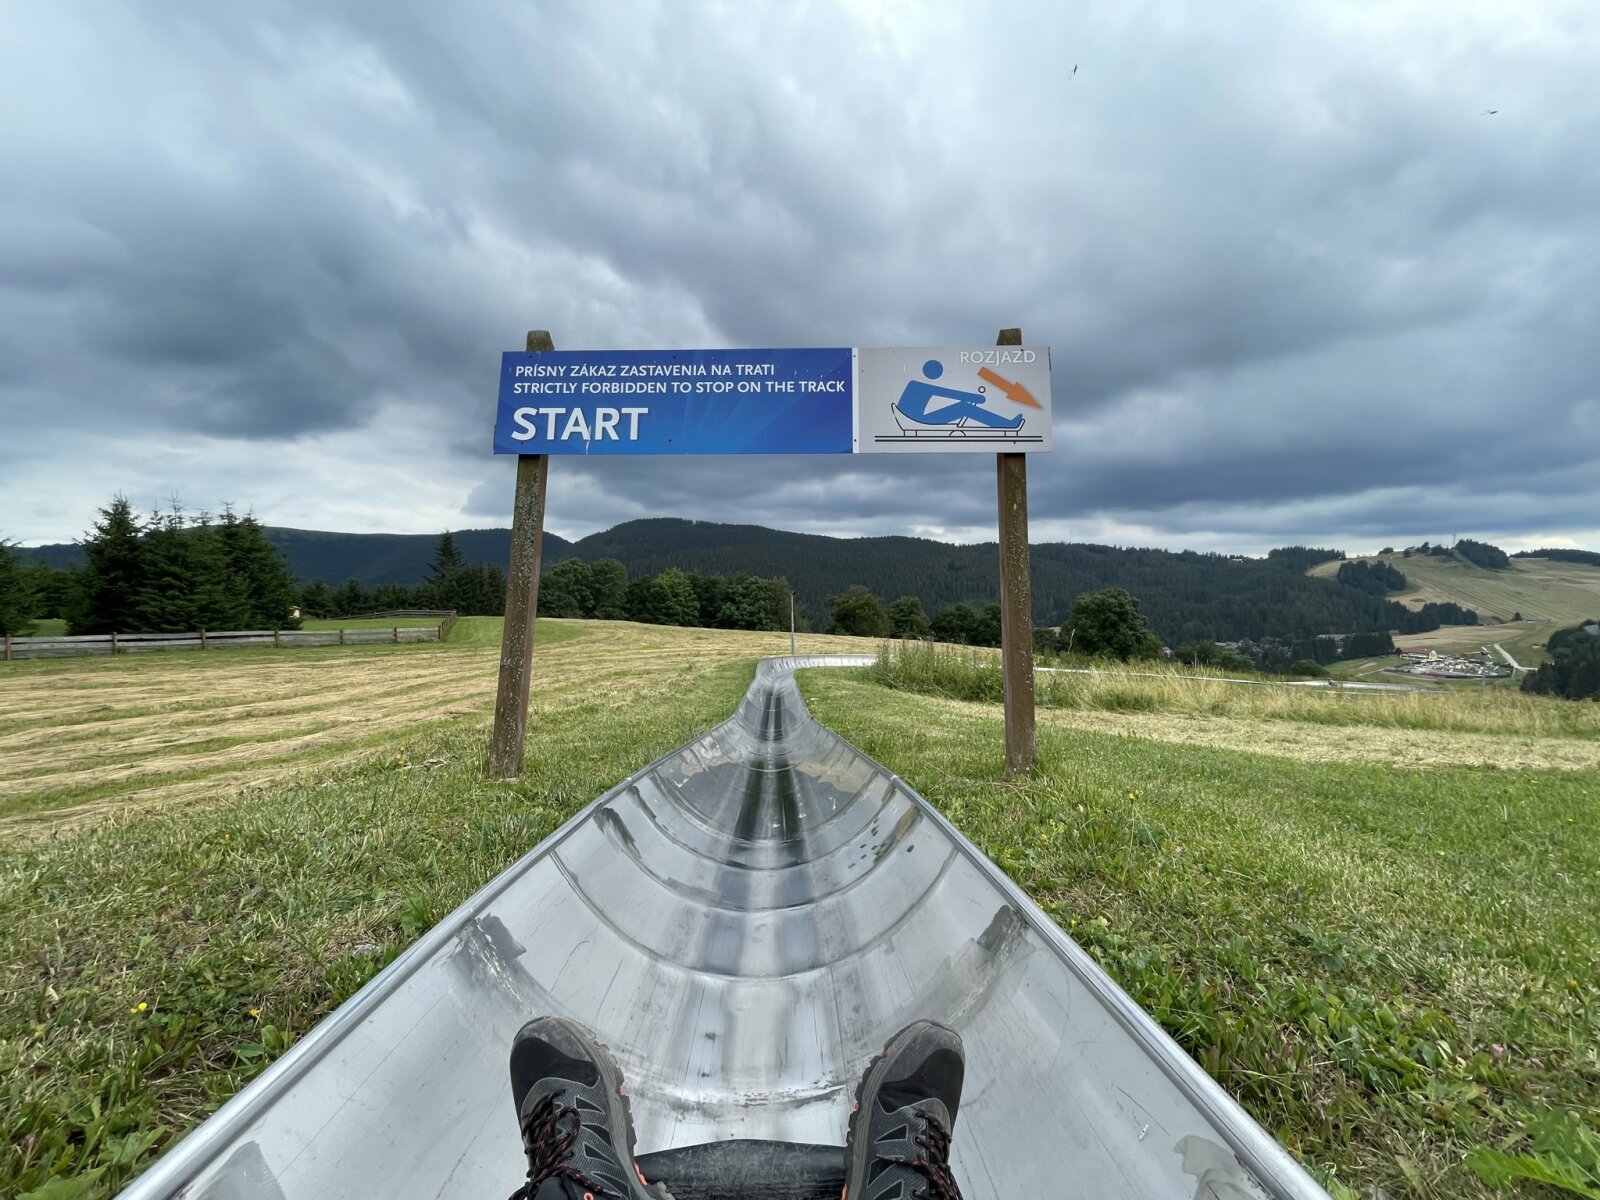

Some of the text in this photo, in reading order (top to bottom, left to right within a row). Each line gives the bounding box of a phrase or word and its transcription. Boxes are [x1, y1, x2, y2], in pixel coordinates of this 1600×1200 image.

[960, 350, 1036, 367] ROZJAZD
[515, 363, 775, 377] PRÍSNY ZÁKAZ ZASTAVENIA NA TRATI
[513, 380, 845, 394] STRICTLY FORBIDDEN TO STOP ON THE TRACK
[511, 407, 648, 441] START
